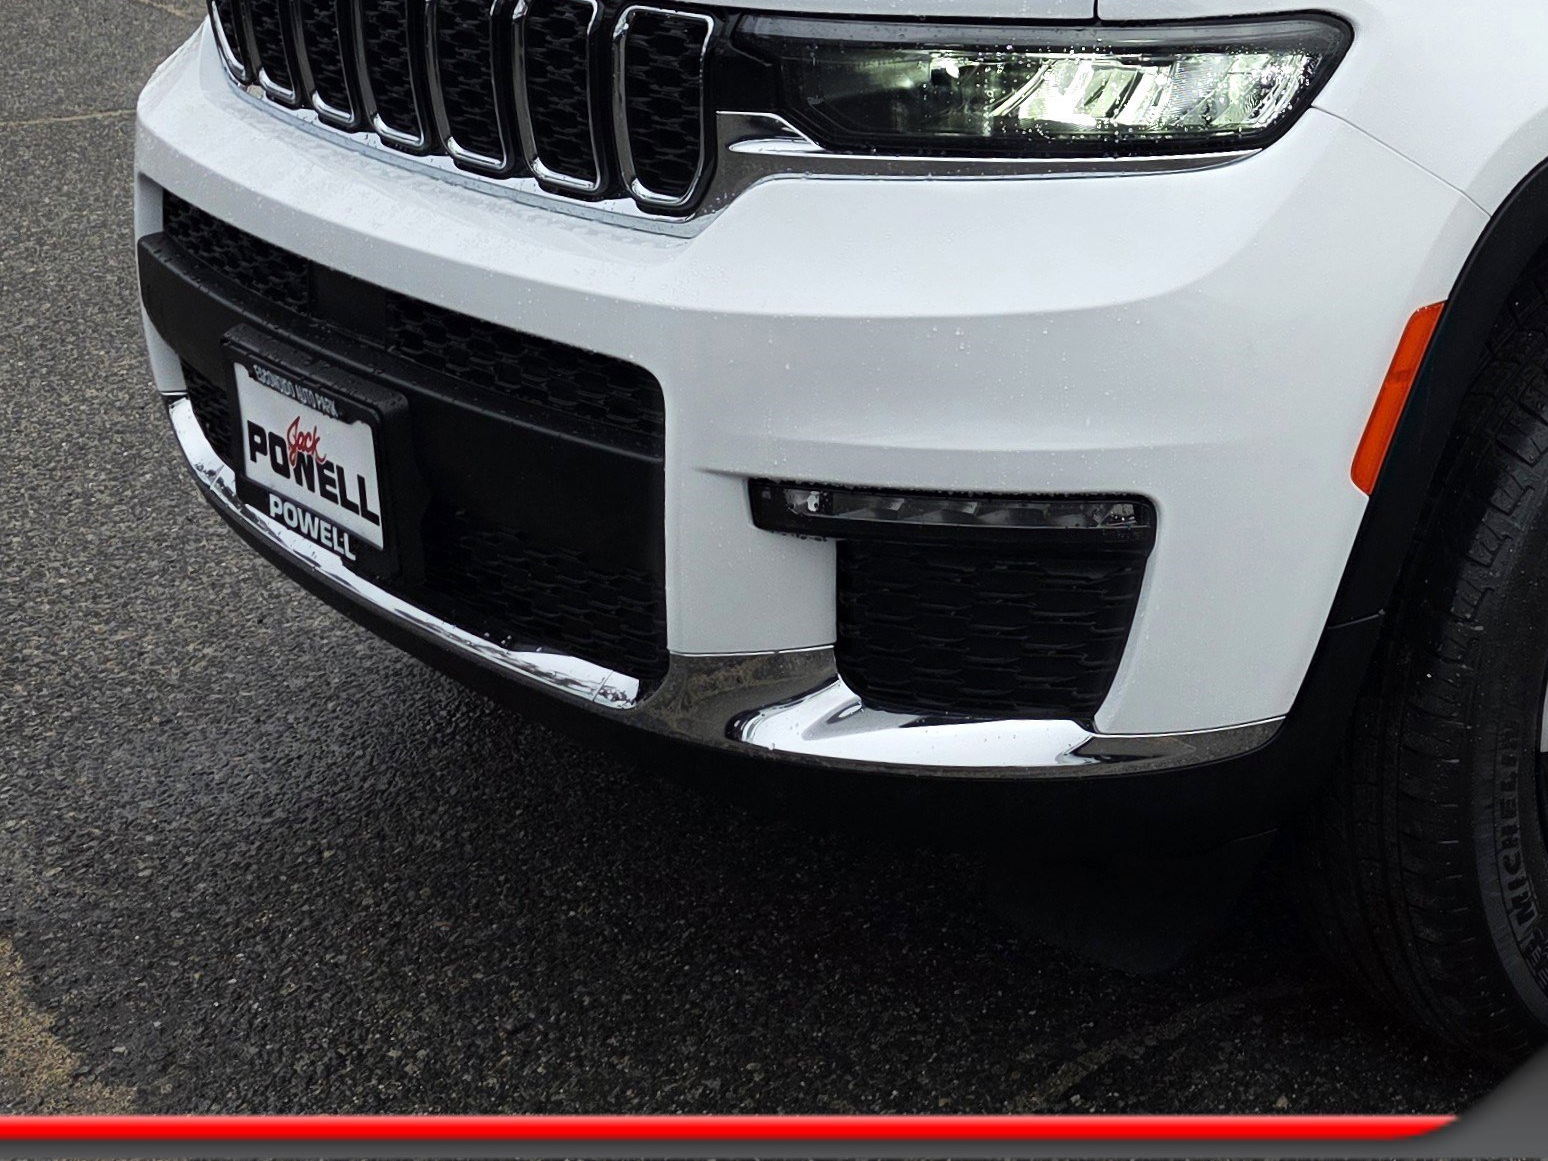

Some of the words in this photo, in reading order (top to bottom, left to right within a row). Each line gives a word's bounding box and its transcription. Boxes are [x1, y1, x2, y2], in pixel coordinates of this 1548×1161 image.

[246, 419, 381, 527] POWELL
[286, 415, 327, 467] Jack
[268, 493, 356, 561] POWELL
